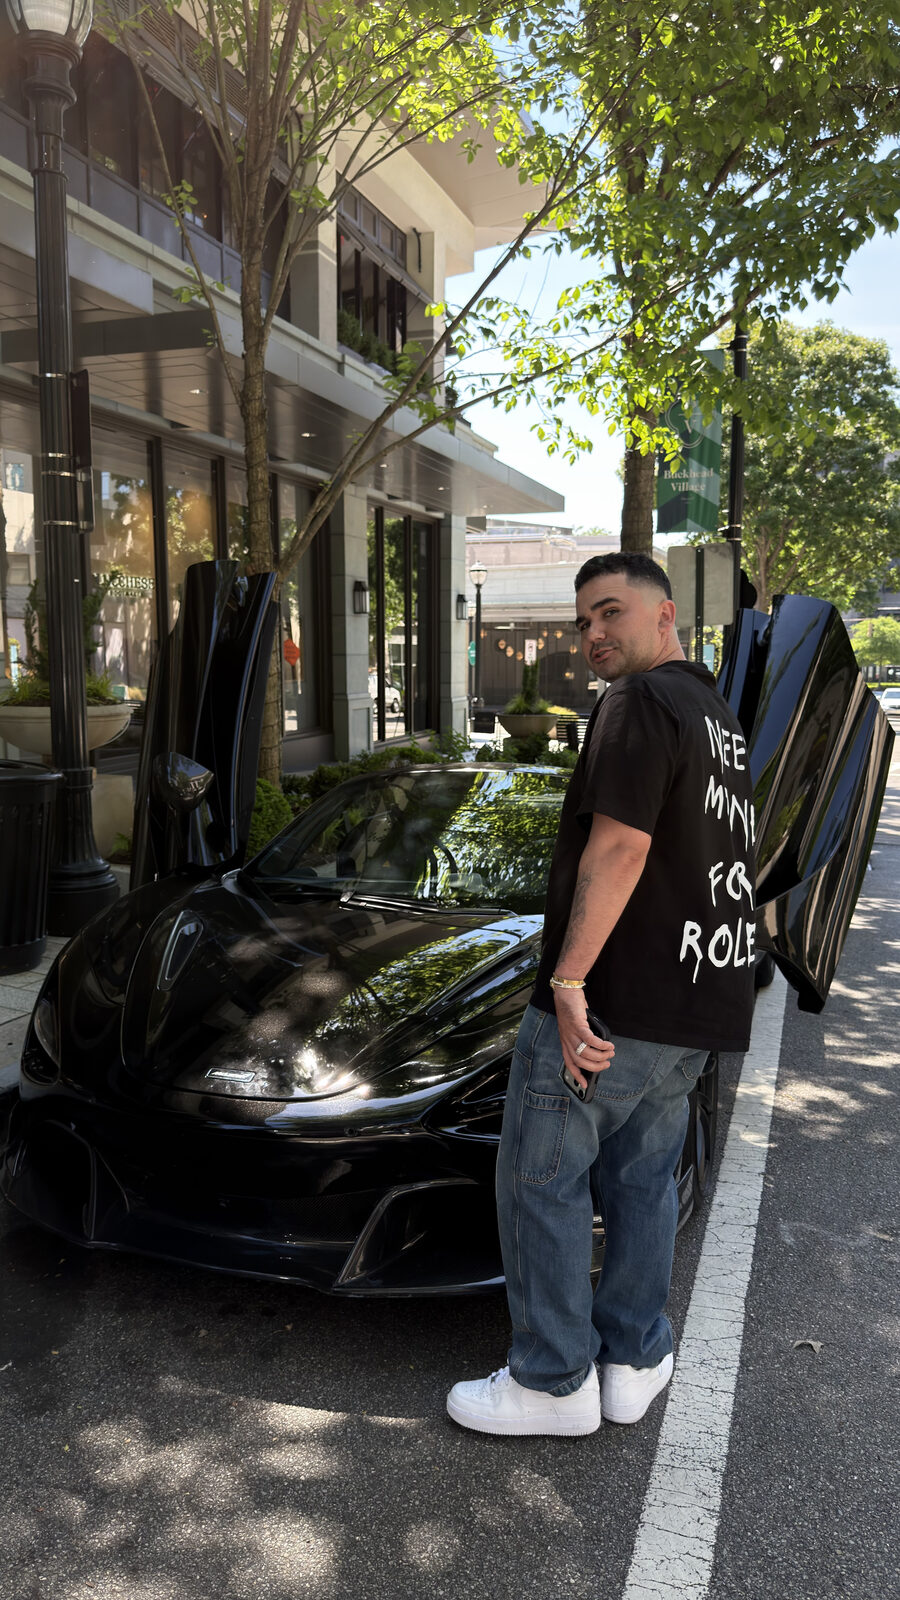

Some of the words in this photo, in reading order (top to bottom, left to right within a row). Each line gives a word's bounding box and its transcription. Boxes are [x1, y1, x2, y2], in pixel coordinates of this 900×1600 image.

[664, 468, 714, 479] Buckhead
[671, 481, 706, 492] Village
[704, 715, 746, 775] NEE
[708, 861, 754, 911] FOR
[679, 917, 757, 984] ROLE
